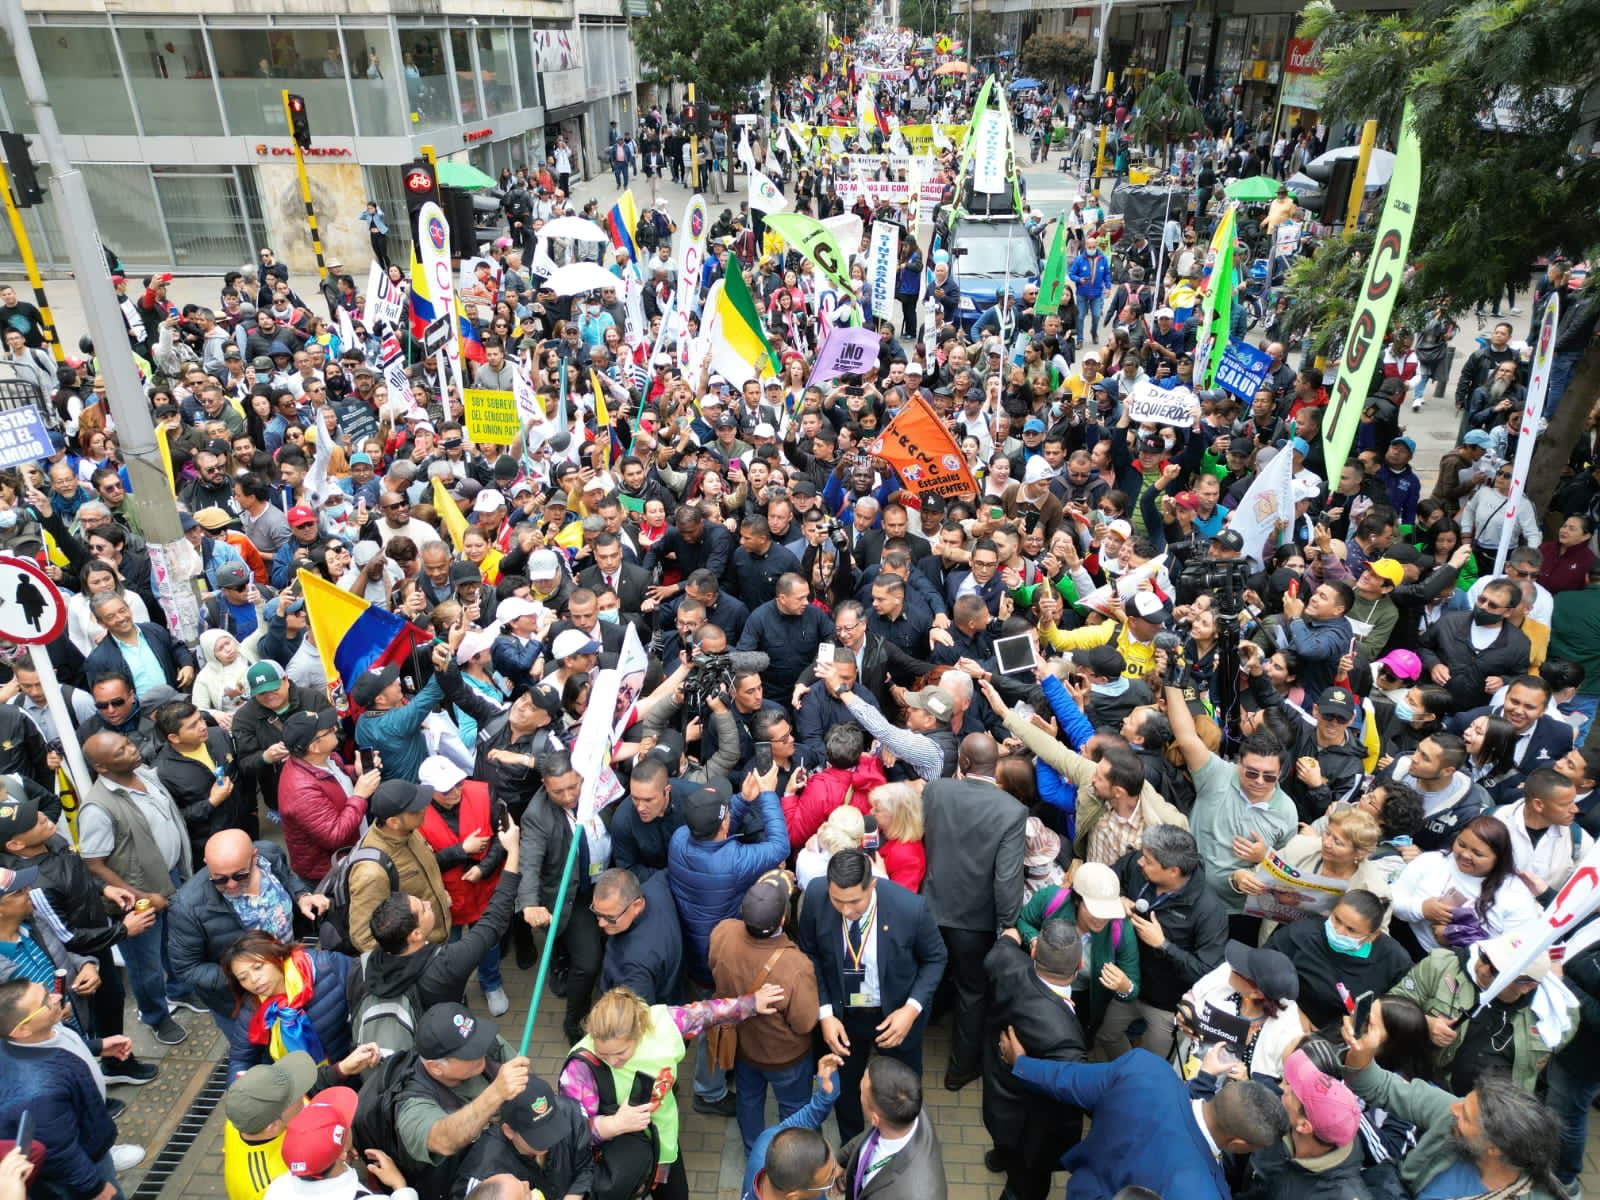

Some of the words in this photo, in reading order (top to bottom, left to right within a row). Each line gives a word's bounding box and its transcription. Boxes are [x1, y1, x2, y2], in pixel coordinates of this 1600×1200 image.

[1217, 365, 1256, 397] SALUD
[15, 427, 35, 443] EL
[1200, 1022, 1238, 1043] rnacional
